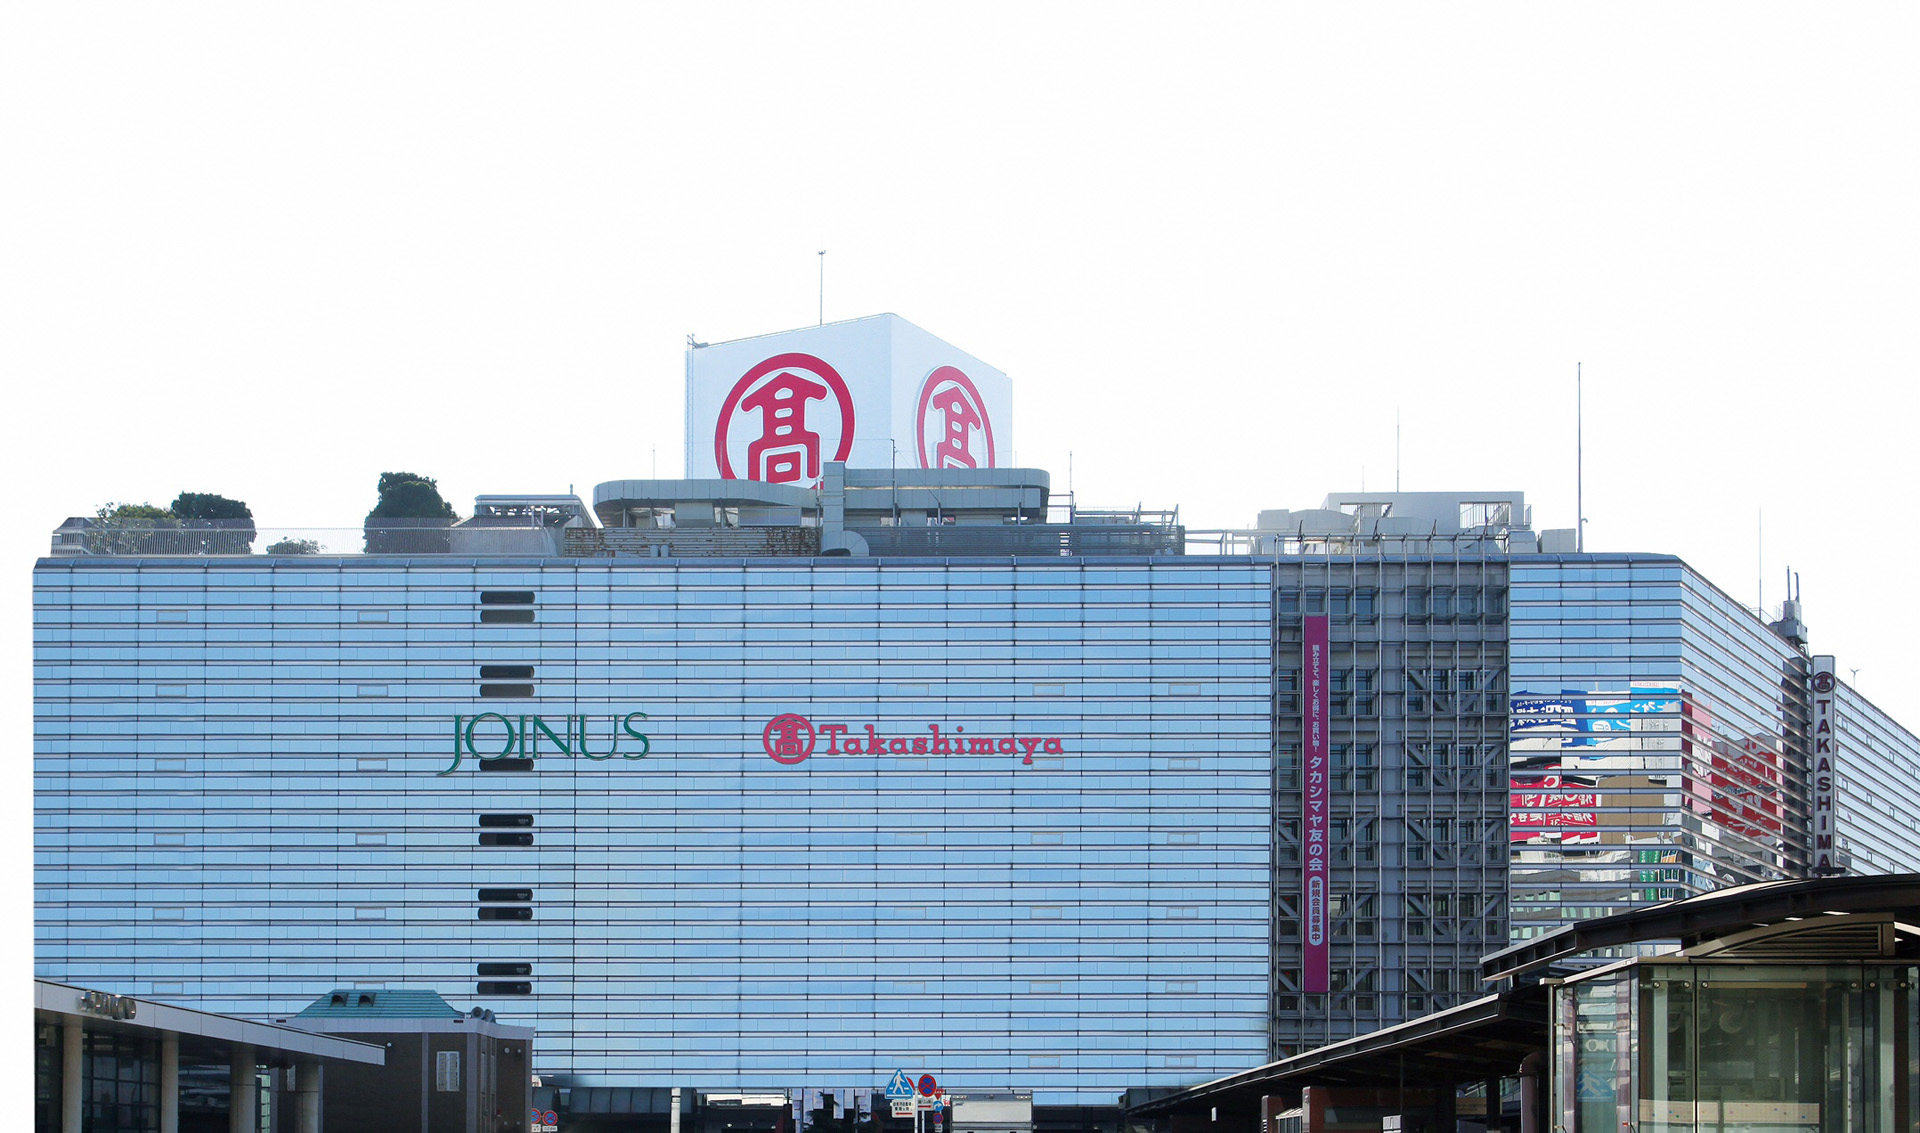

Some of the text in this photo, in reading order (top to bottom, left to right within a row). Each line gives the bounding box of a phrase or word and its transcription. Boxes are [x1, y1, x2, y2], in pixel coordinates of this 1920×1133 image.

[436, 712, 650, 776] JOINUS
[819, 724, 1064, 765] Takashimaya
[1309, 756, 1323, 872] タカシマヤ友の会
[1816, 699, 1832, 868] TAKASHIMA
[1311, 880, 1321, 942] 新規会員募集中
